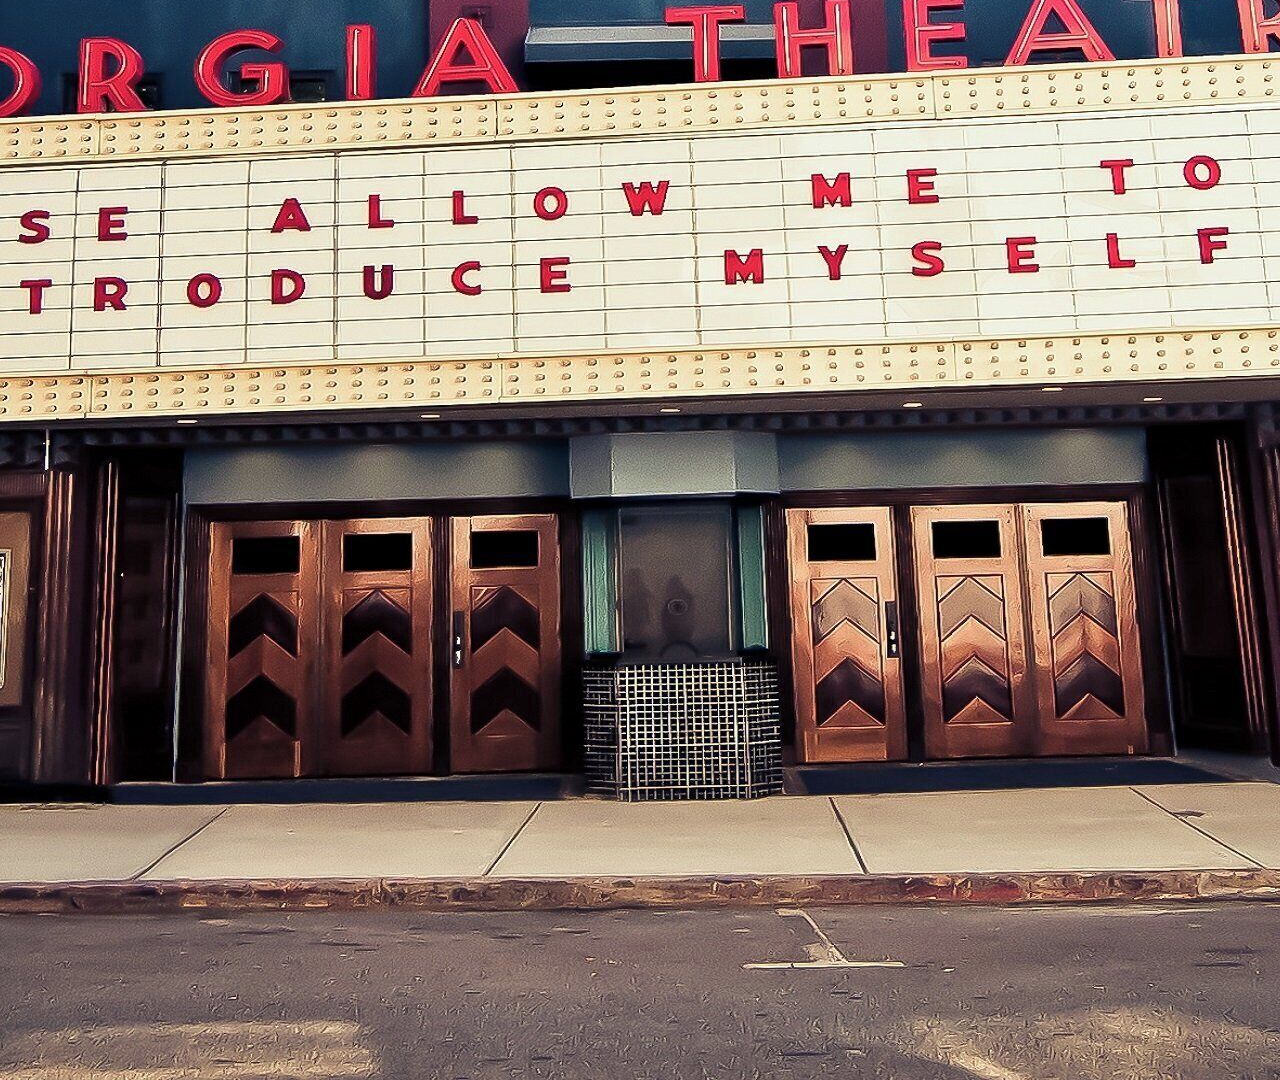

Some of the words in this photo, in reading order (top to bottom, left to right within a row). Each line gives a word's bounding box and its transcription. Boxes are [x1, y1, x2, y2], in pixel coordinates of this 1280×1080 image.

[270, 180, 671, 234] ALLOW
[809, 168, 940, 209] ME
[1099, 154, 1223, 195] TO
[723, 226, 1230, 286] MYSELF
